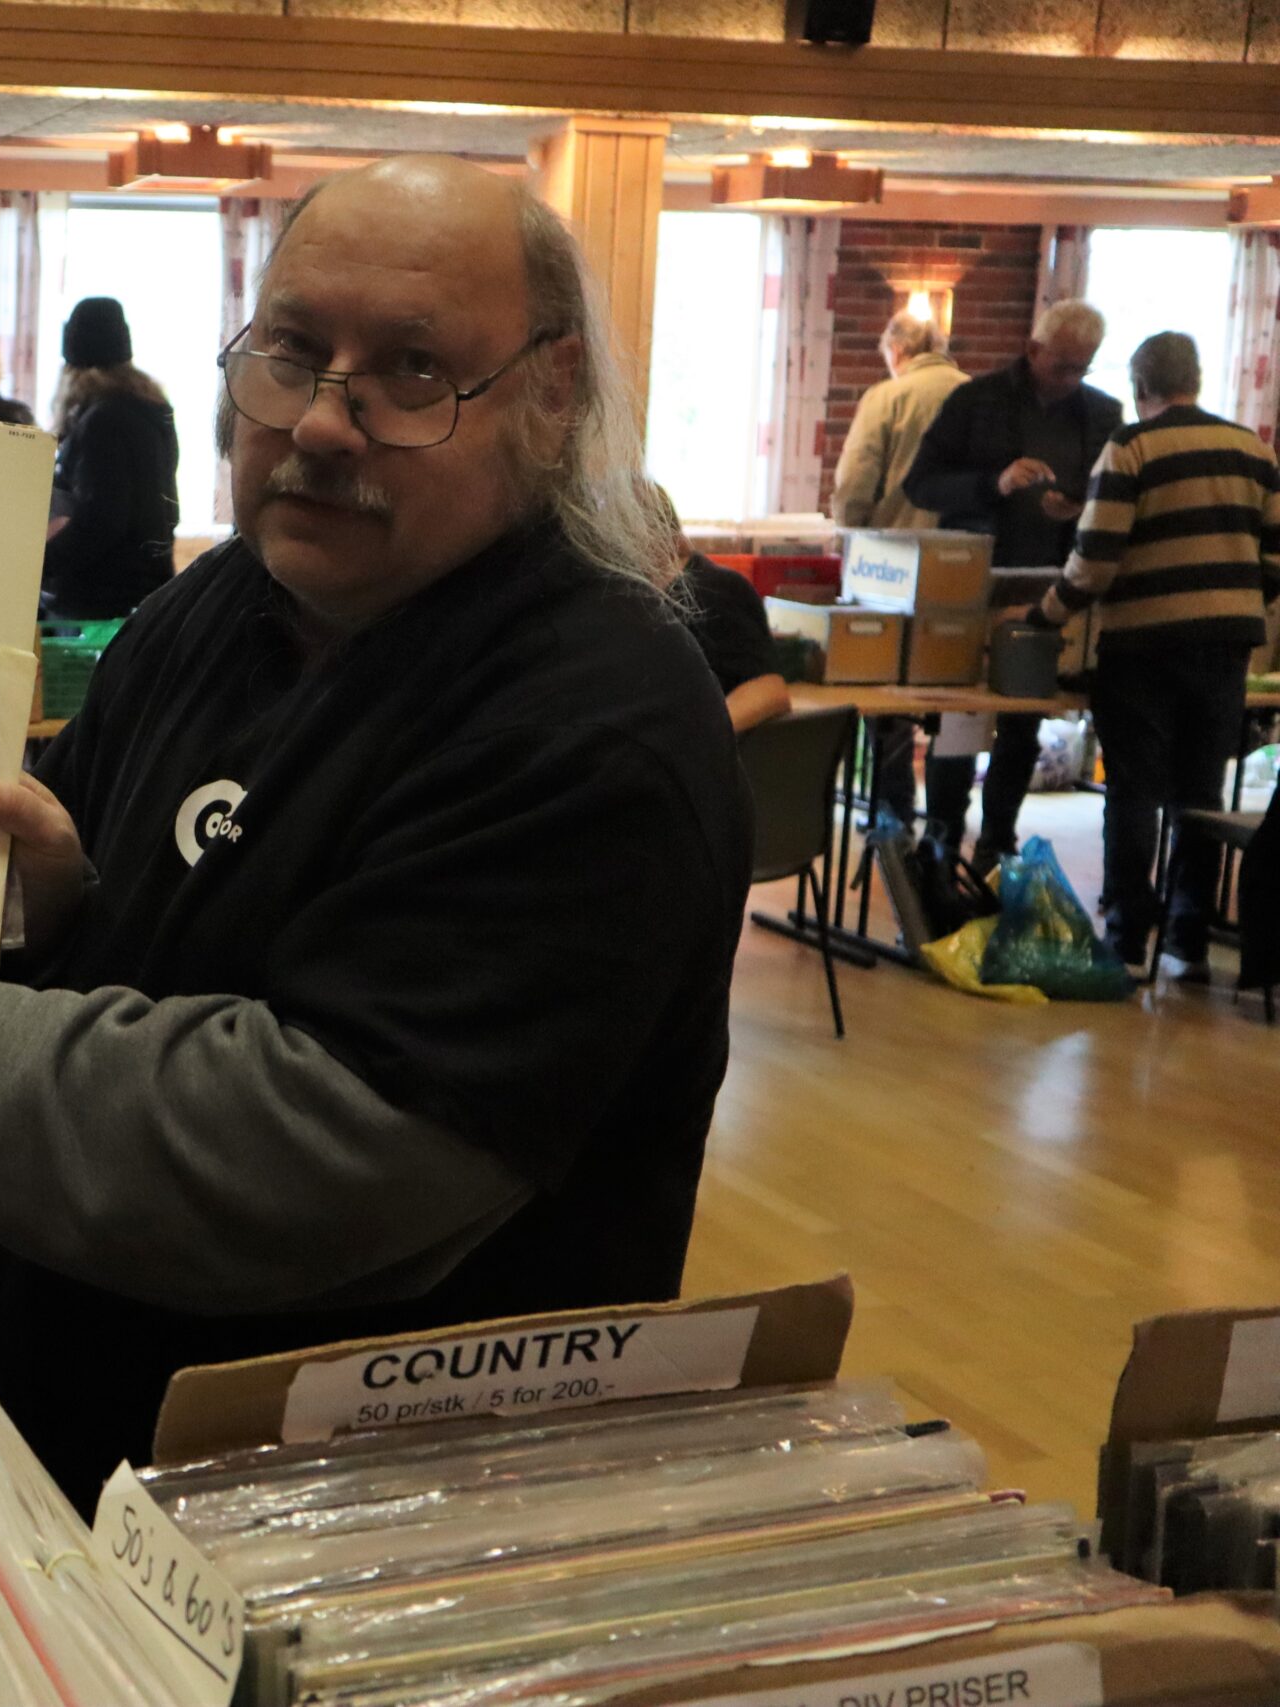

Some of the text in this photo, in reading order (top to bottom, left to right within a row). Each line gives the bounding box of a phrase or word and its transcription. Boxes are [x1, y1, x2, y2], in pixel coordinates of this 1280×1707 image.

[851, 554, 907, 584] Jordan
[362, 1323, 642, 1389] COUNTRY
[357, 1403, 388, 1424] 50
[396, 1393, 465, 1424] pr/stk
[489, 1389, 506, 1408] 5
[512, 1384, 547, 1406] for
[552, 1376, 617, 1400] 200,-
[905, 1670, 1031, 1707] PRISER
